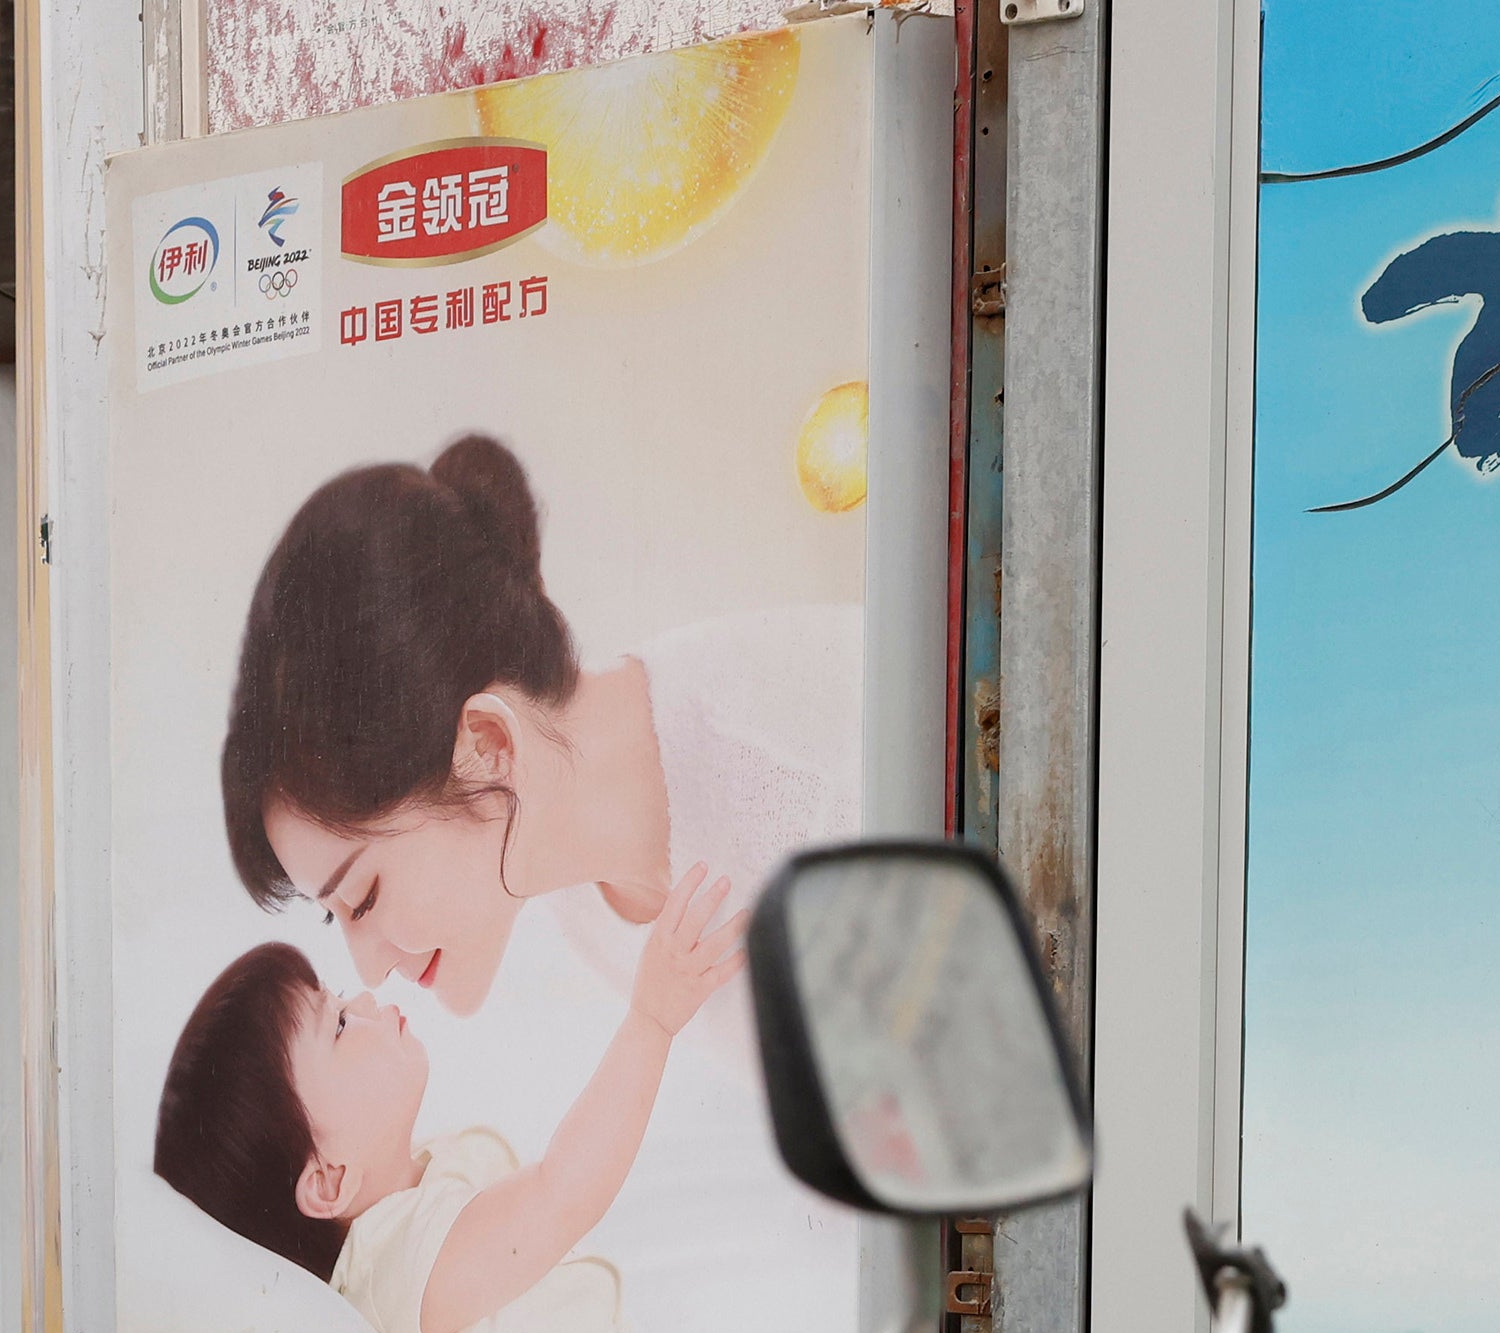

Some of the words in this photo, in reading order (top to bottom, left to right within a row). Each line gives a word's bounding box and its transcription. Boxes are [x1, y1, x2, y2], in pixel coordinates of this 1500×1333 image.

[377, 165, 510, 243] 金领冠
[157, 239, 209, 283] 伊利
[247, 252, 282, 273] BEIJING
[283, 249, 309, 265] 2022
[340, 275, 549, 346] 中国专利配方
[147, 359, 168, 372] Official
[168, 353, 189, 366] Partner
[189, 350, 196, 360] of
[196, 348, 207, 358] the
[206, 343, 232, 357] Olympic
[231, 338, 252, 350] Winter
[252, 334, 273, 346] Games
[273, 329, 295, 342] Beijing
[295, 325, 311, 337] 2022
